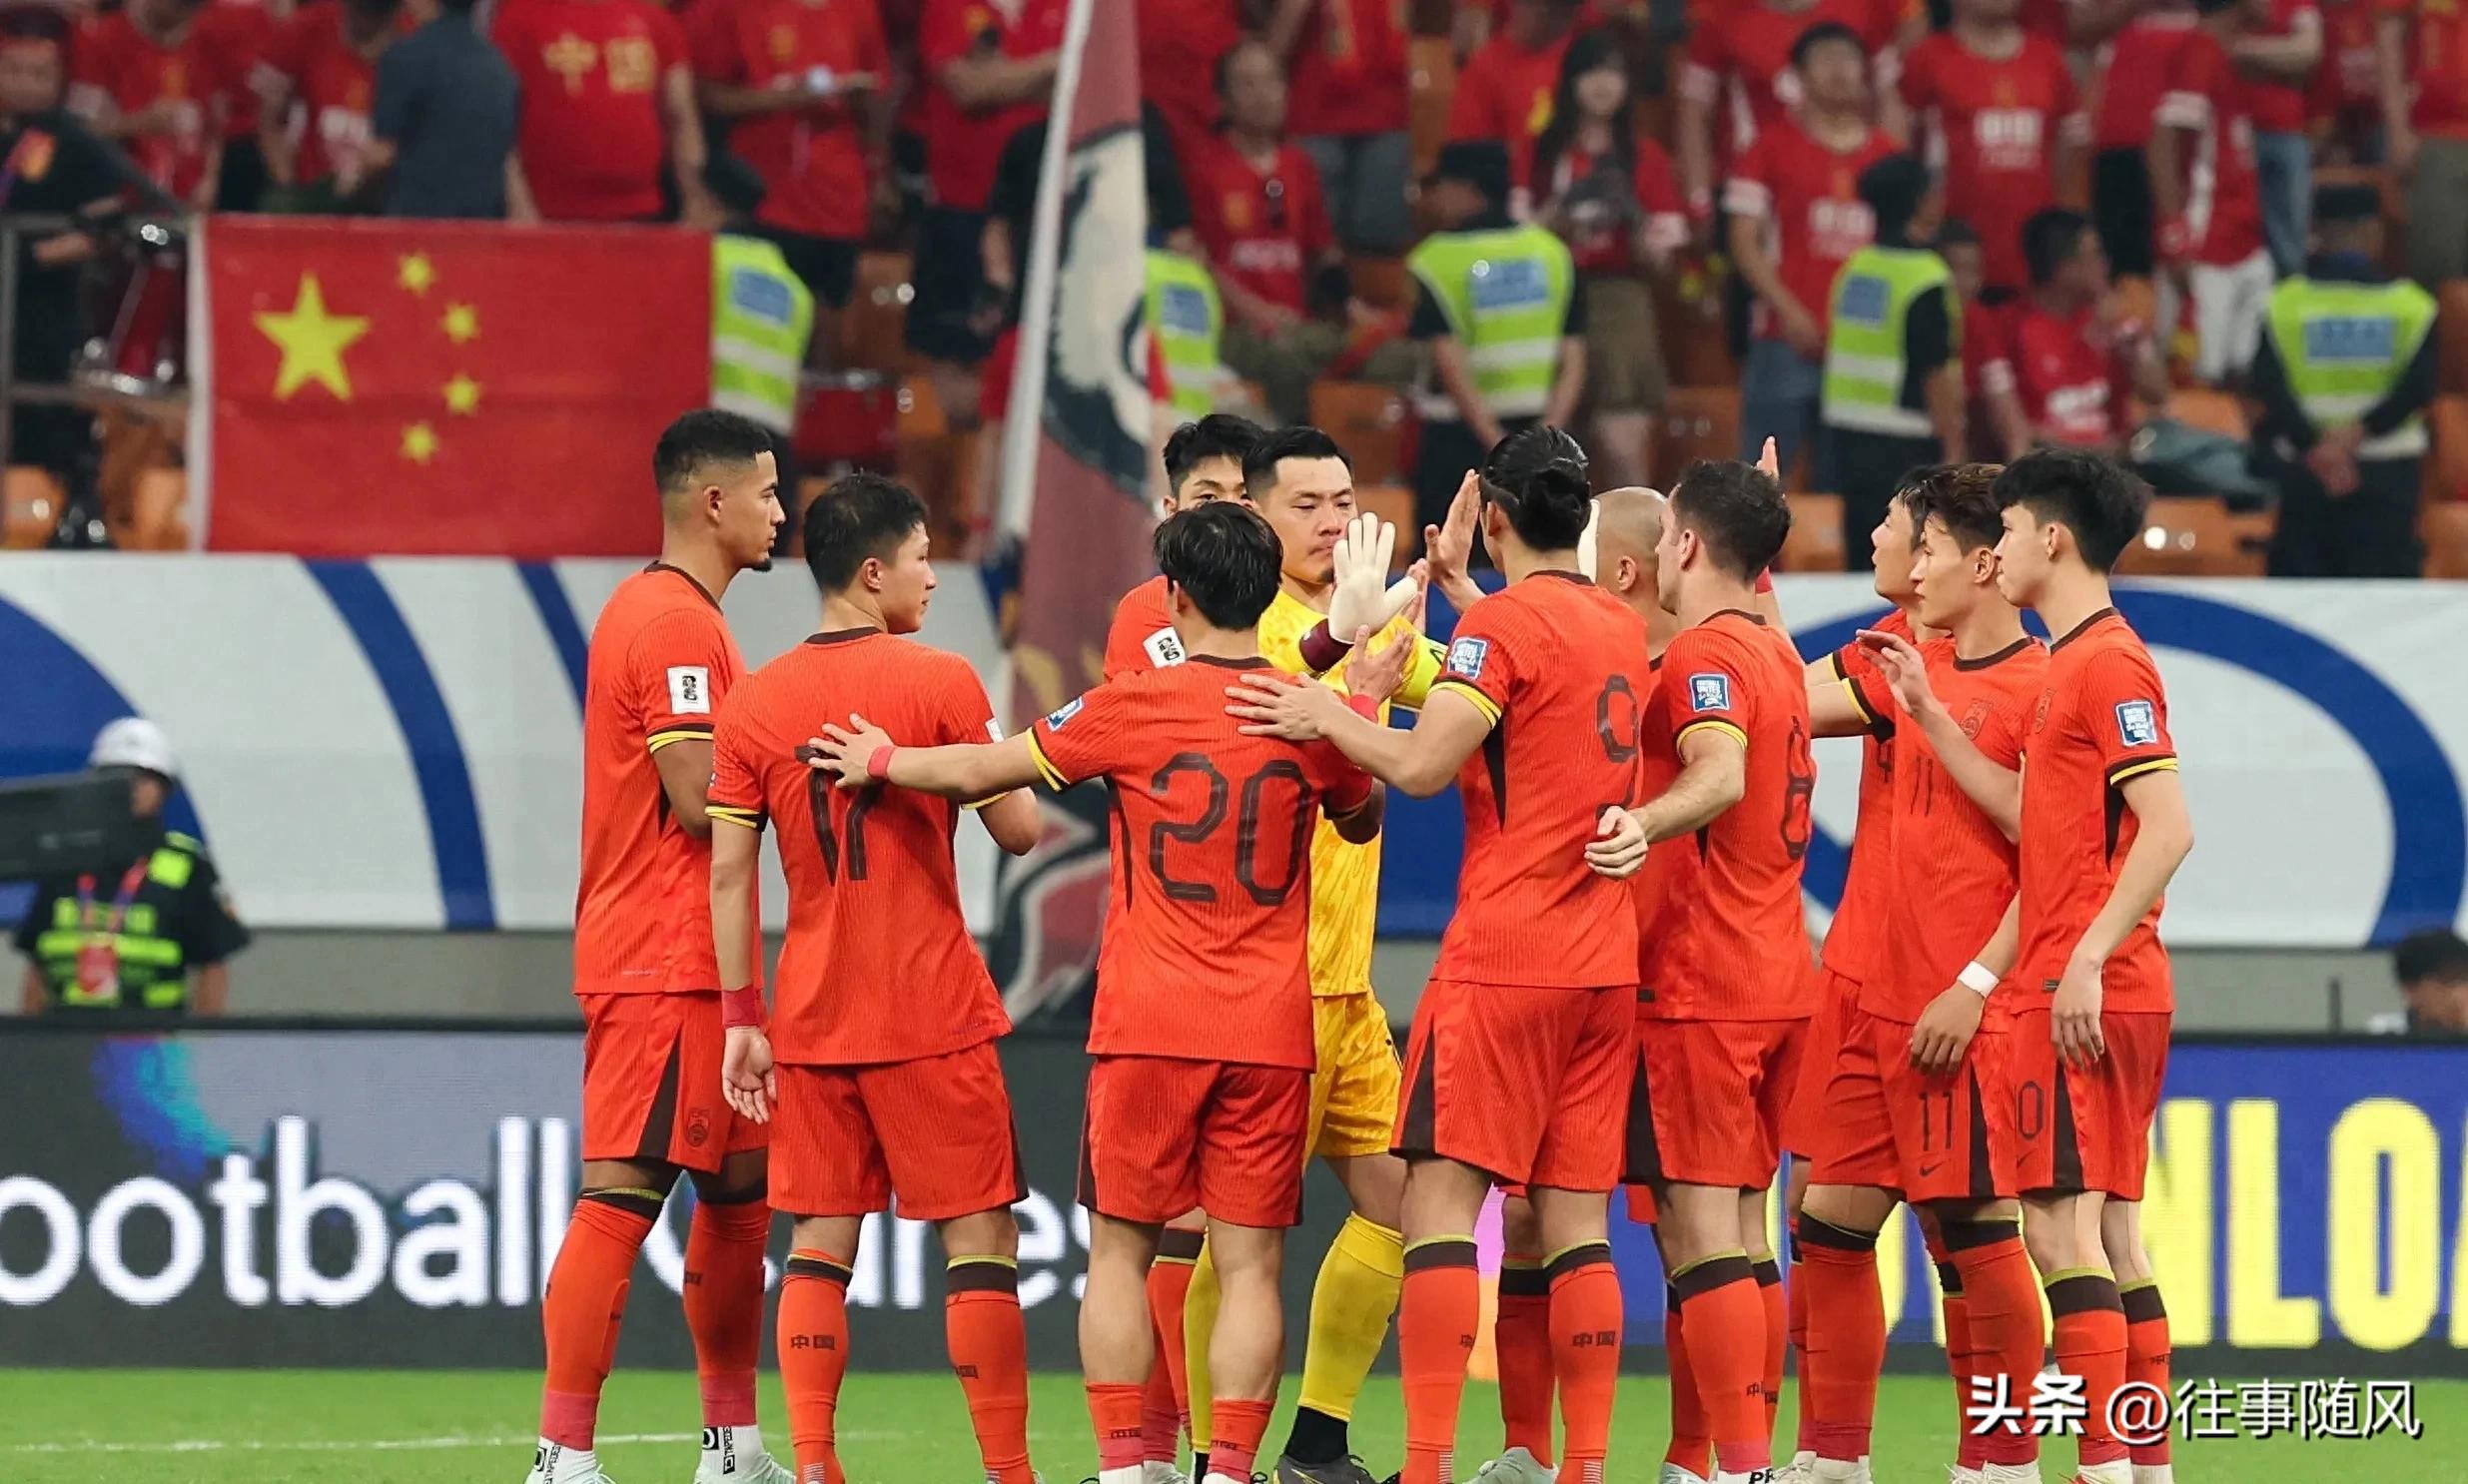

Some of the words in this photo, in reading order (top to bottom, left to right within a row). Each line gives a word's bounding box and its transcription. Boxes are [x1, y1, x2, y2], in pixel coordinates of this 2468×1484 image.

[1597, 674, 1639, 825] 9
[1780, 715, 1815, 861] 8
[1910, 754, 1933, 818] 11
[1149, 752, 1311, 906] 20
[1918, 1091, 1953, 1151] 11
[2018, 1081, 2044, 1139] 0
[790, 1334, 835, 1350] 中国
[1572, 1331, 1615, 1347] 中国
